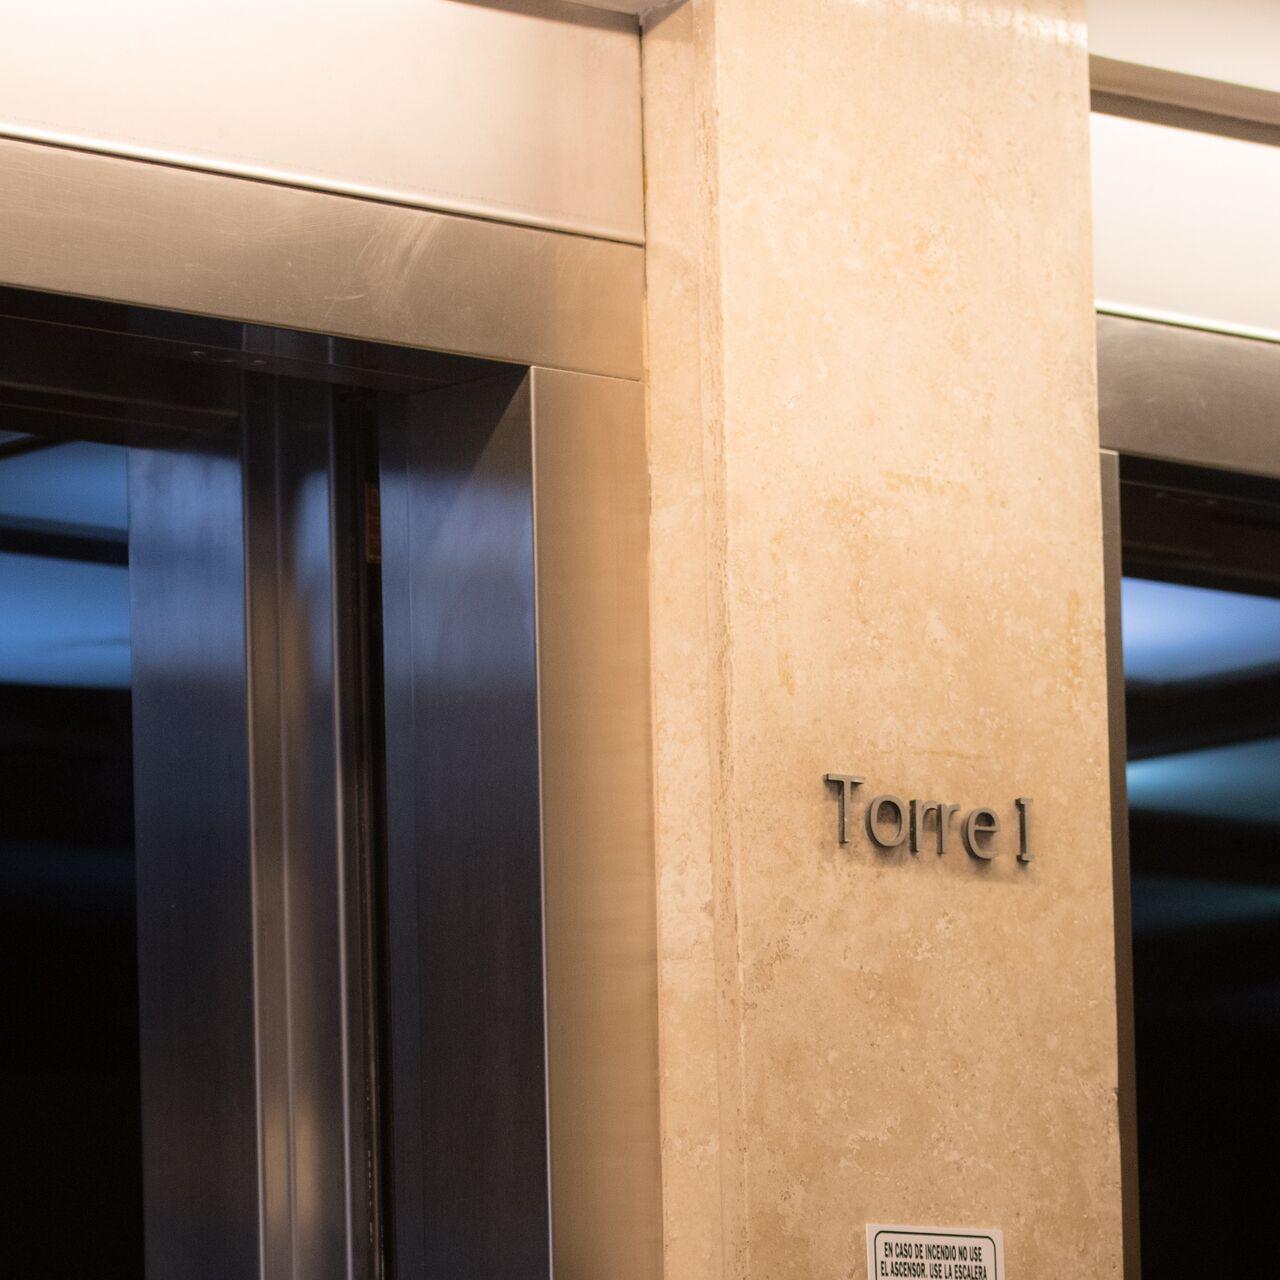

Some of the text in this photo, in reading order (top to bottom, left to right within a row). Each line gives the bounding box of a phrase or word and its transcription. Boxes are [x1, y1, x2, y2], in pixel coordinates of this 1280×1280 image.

[884, 1242, 983, 1262] EN CASO DE INCENDIO NO USE
[881, 1260, 988, 1280] EL ASCENSOR. USE LA ESCALERA
